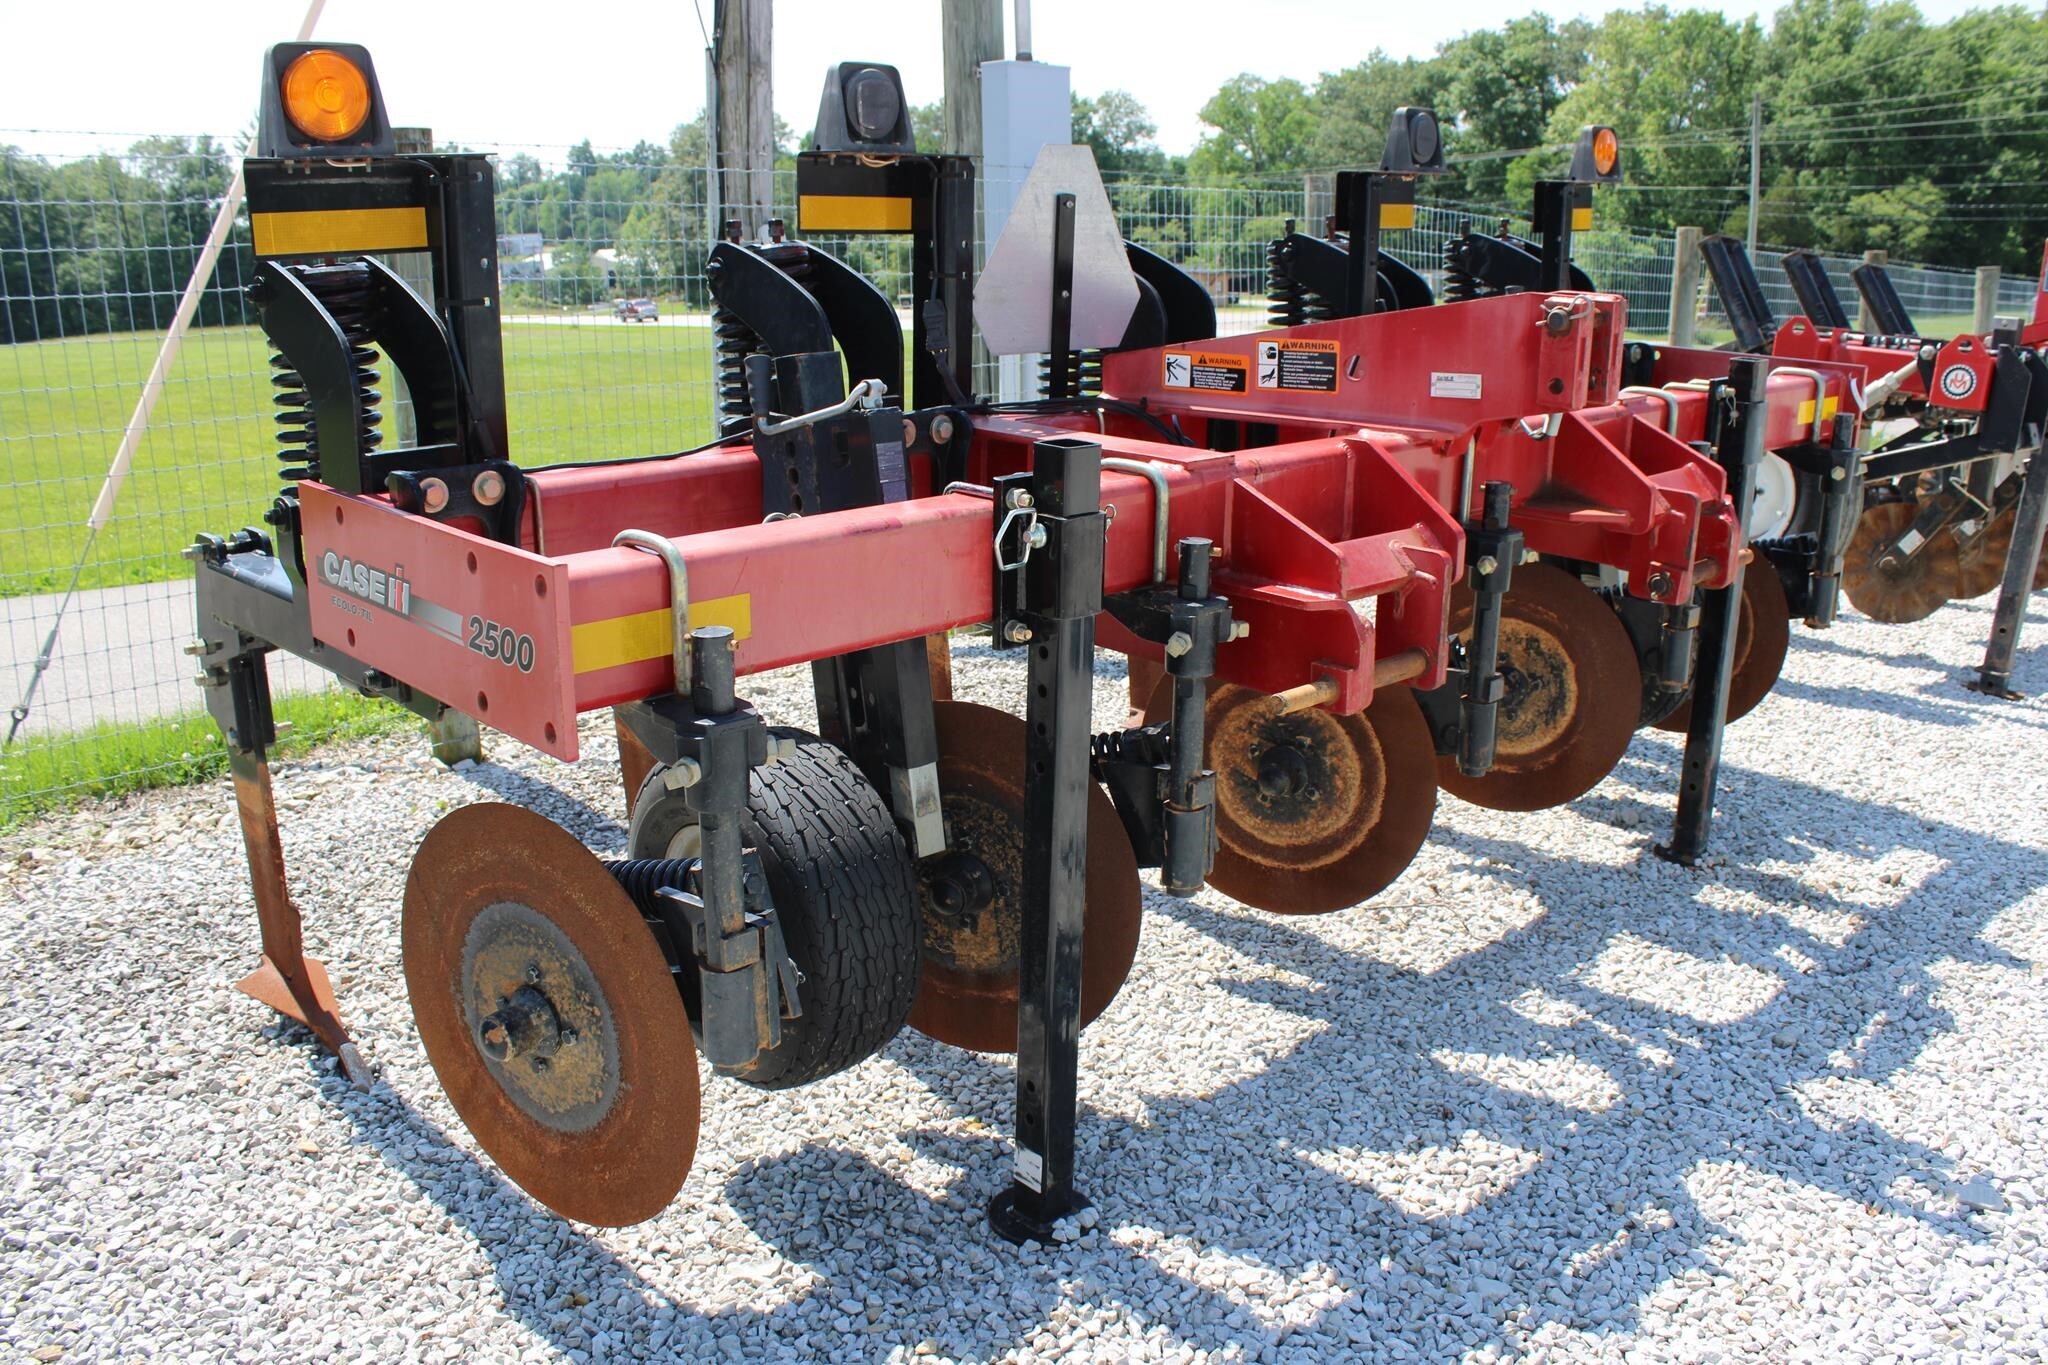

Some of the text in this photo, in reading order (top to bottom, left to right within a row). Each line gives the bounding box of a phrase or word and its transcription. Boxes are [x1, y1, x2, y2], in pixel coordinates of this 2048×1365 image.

[1290, 341, 1335, 351] WARNING
[1209, 357, 1242, 366] WARNING
[468, 614, 535, 674] 2500
